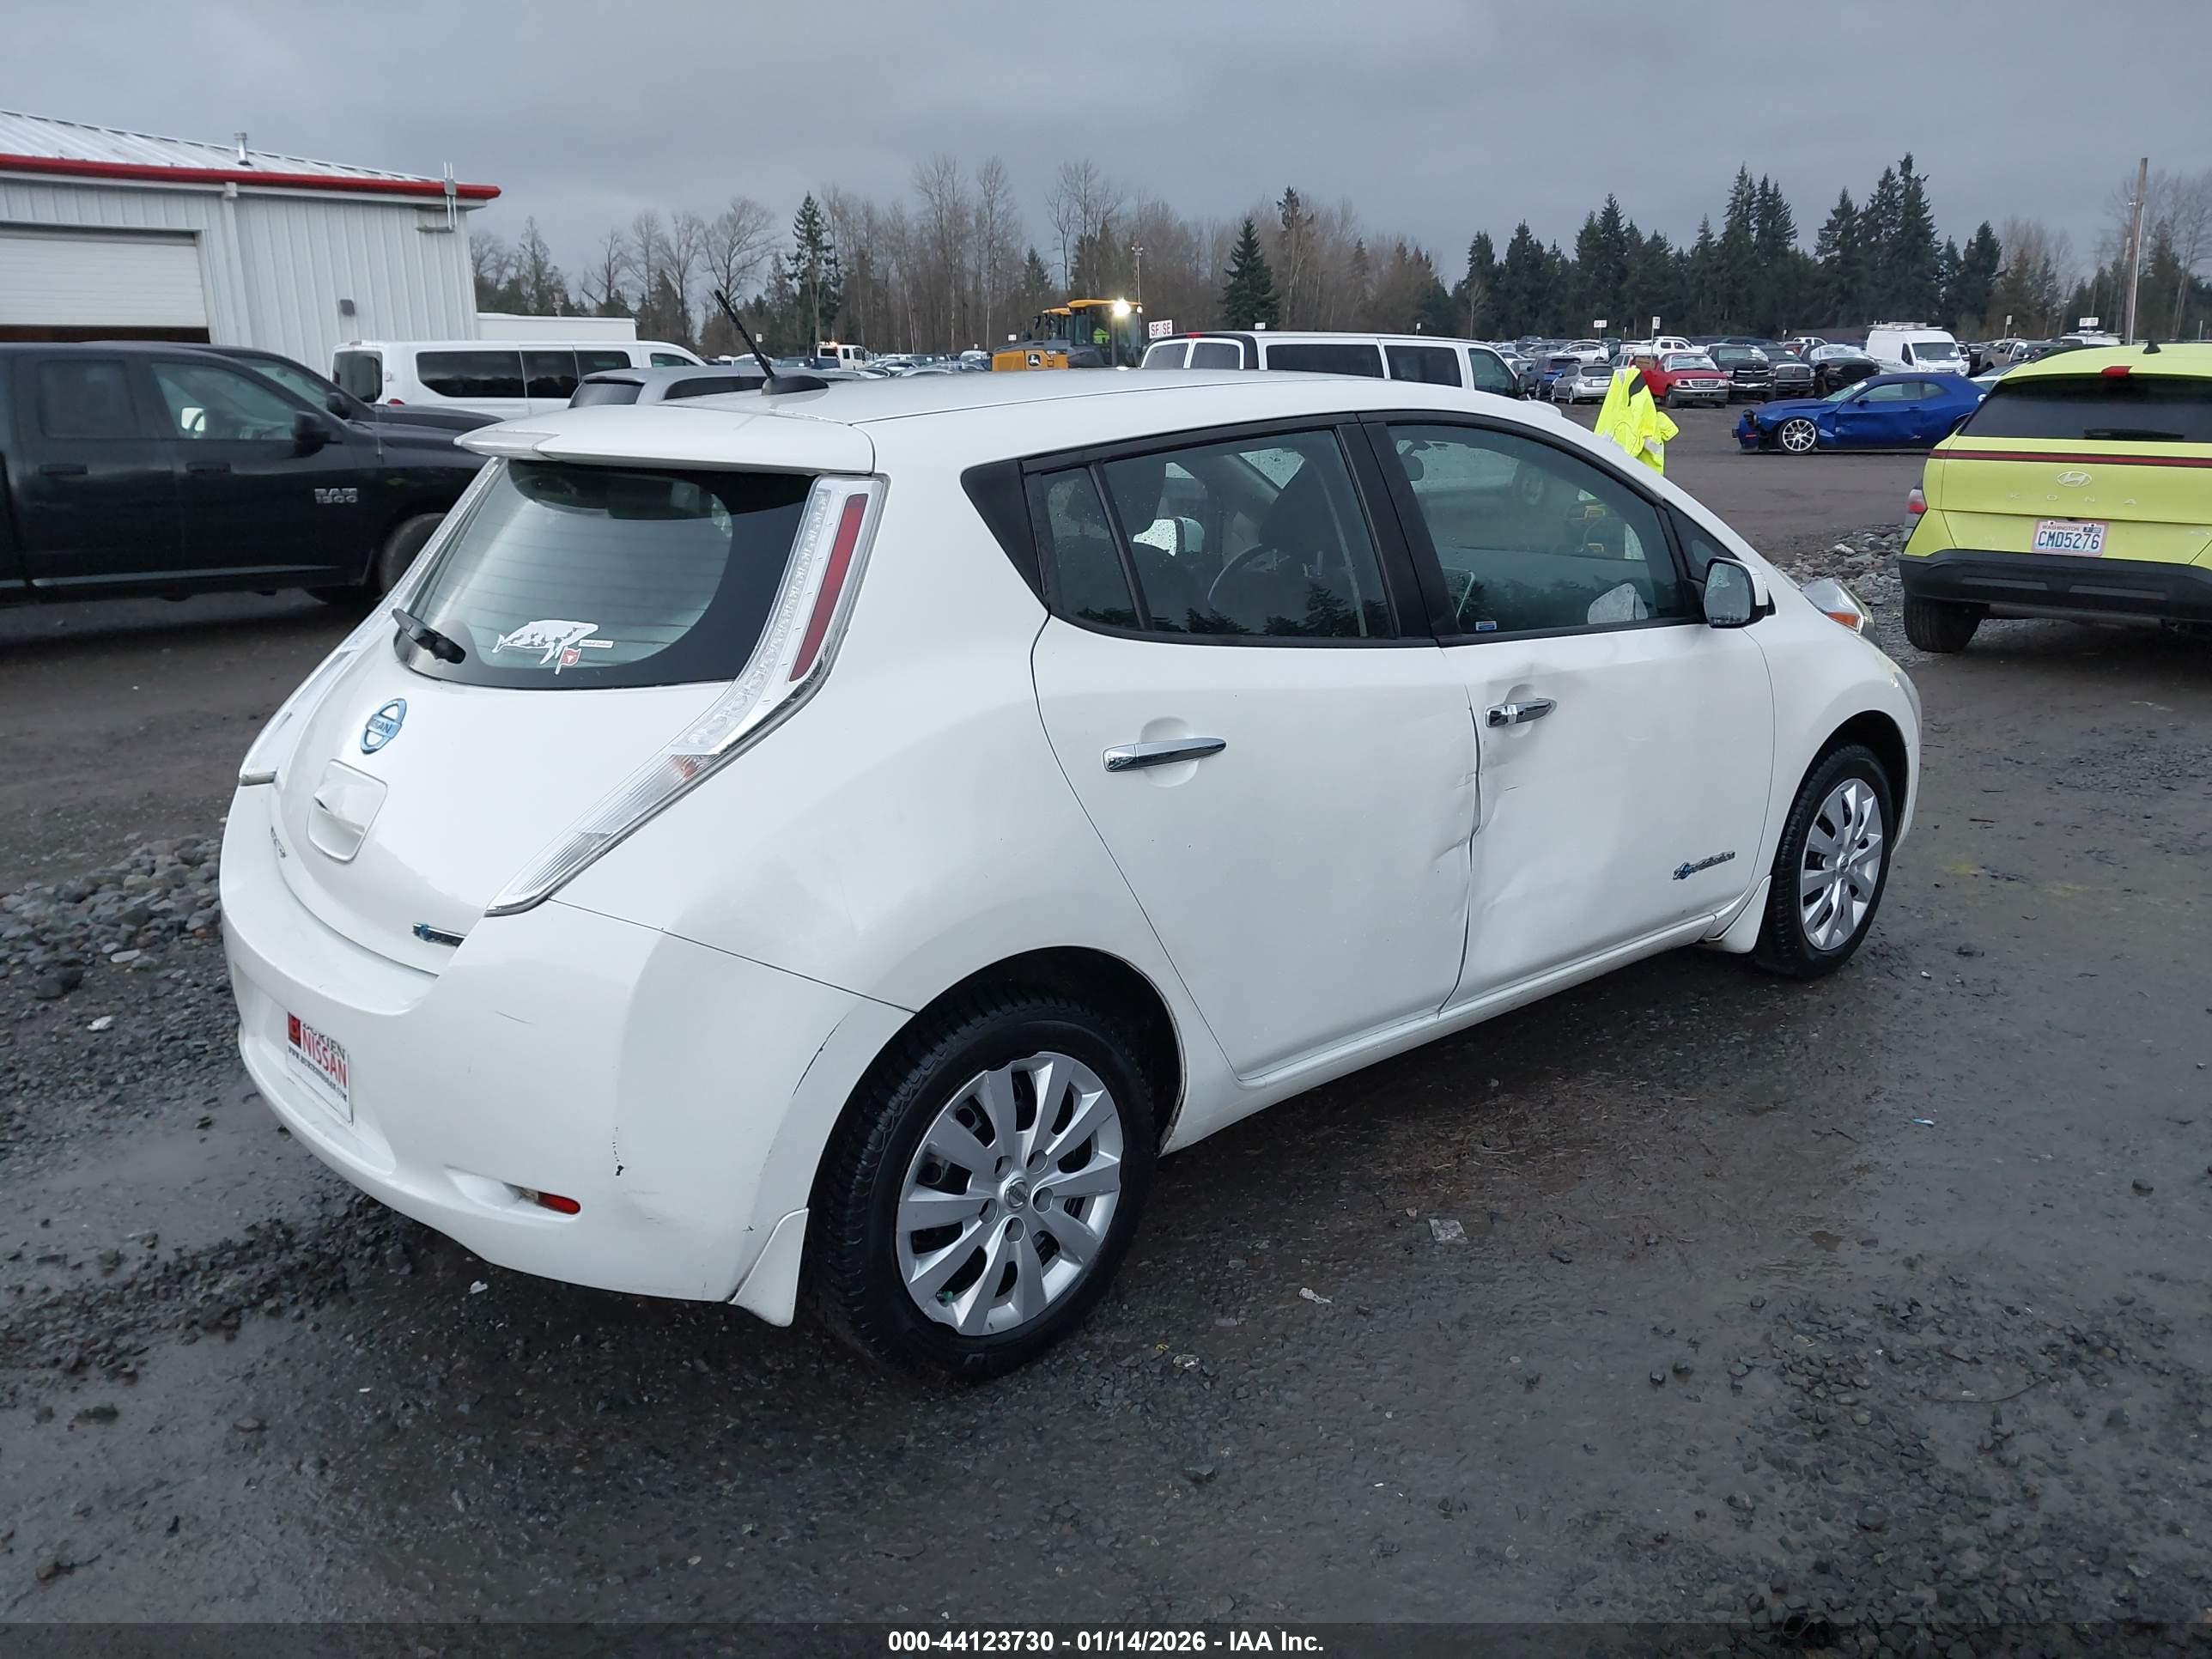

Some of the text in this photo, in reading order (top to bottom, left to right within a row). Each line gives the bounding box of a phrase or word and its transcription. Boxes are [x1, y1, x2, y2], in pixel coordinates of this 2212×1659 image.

[1163, 322, 1171, 335] SE
[2007, 494, 2137, 507] KONA
[2038, 531, 2100, 550] CMD5276
[302, 1029, 347, 1089] NISSAN
